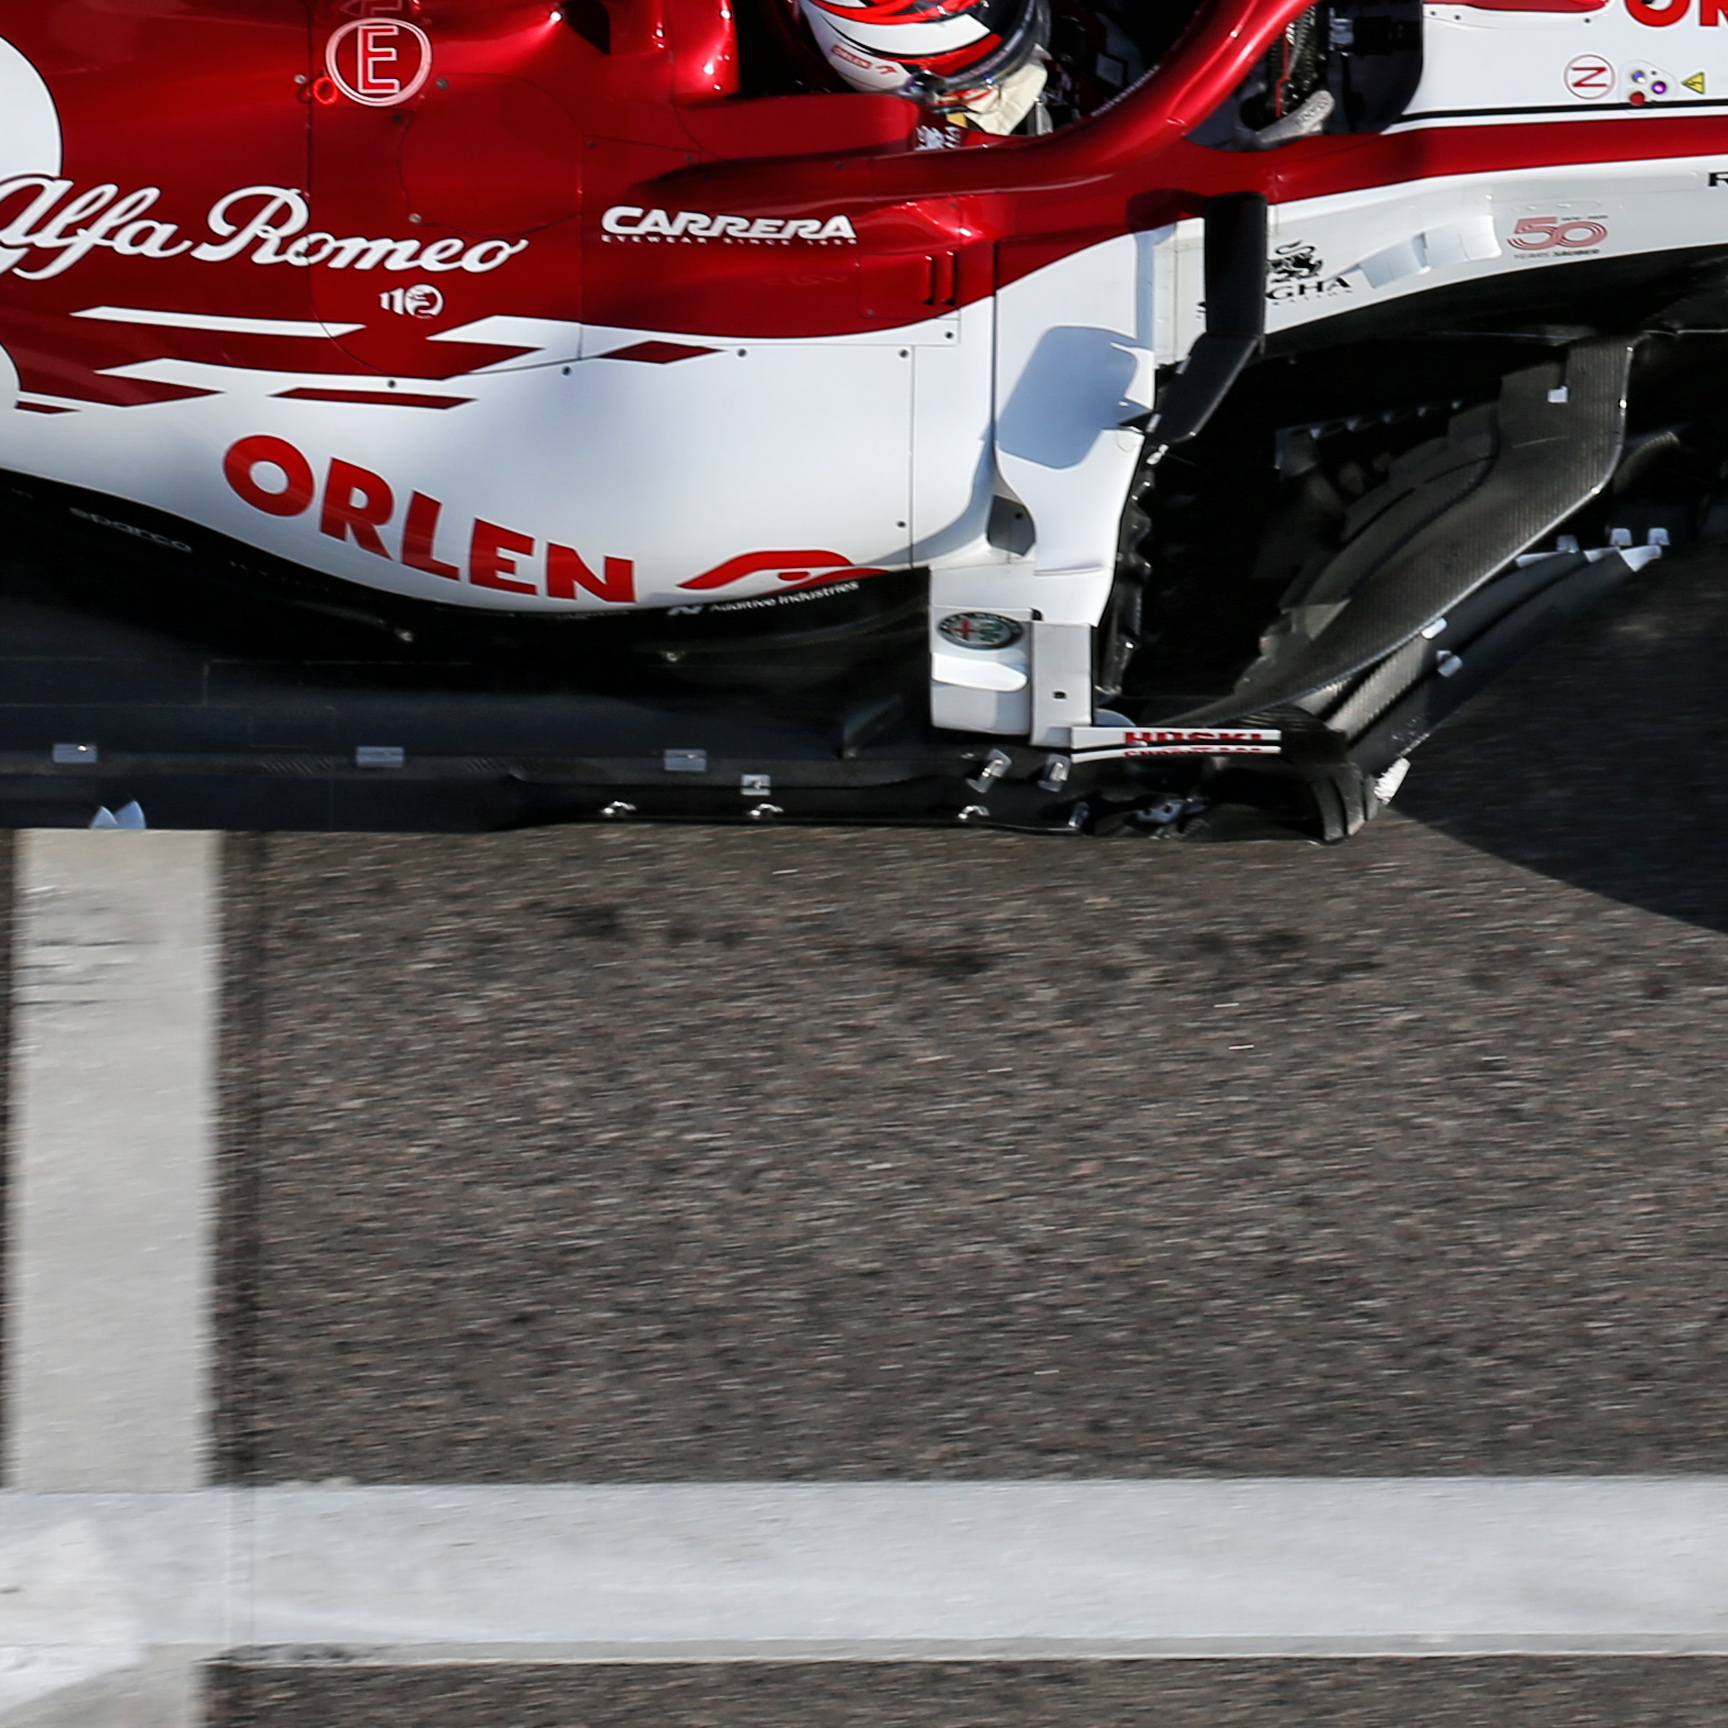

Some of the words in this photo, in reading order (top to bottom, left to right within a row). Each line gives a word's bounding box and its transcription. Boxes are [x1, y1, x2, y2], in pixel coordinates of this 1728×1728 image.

[190, 183, 530, 275] Romeo
[601, 205, 858, 240] CARRERA
[1506, 217, 1609, 251] 50
[222, 433, 636, 605] ORLEN
